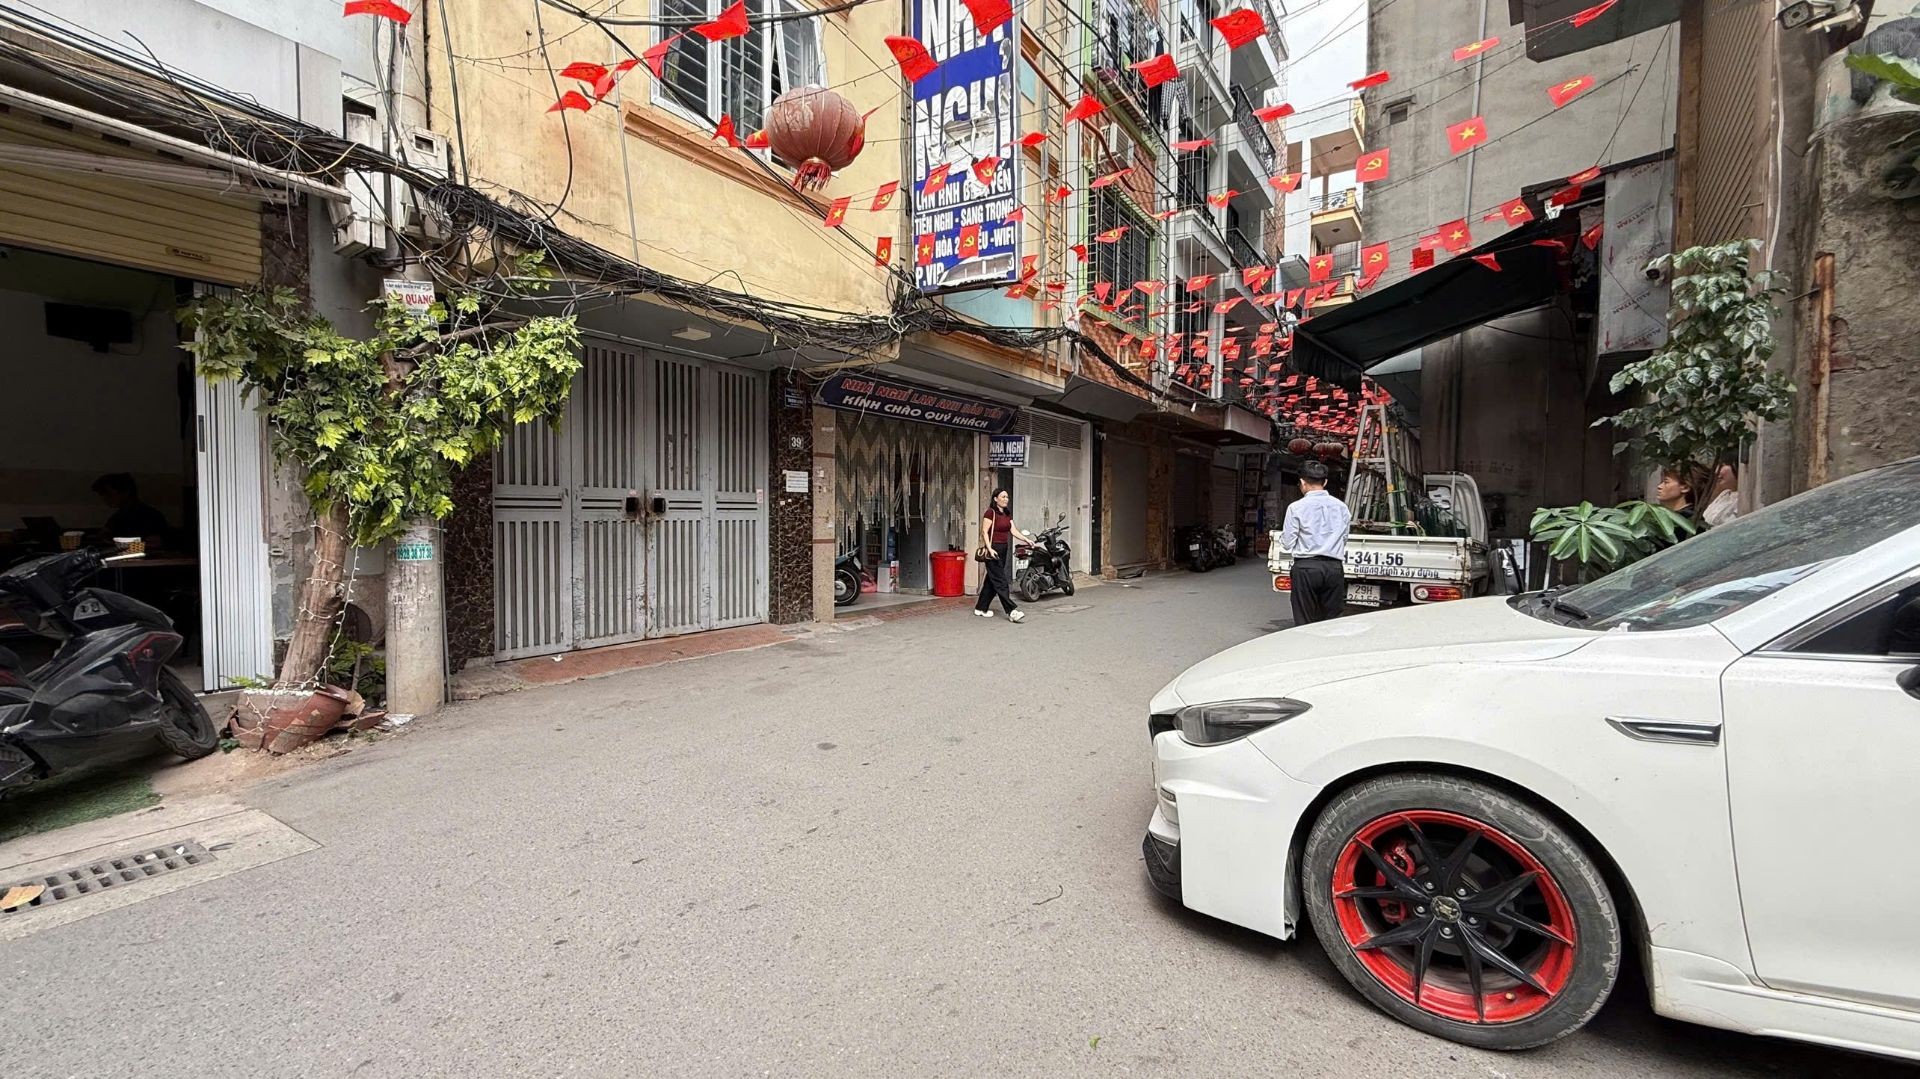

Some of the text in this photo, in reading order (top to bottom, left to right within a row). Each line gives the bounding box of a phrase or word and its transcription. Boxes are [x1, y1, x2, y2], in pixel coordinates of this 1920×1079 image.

[960, 204, 984, 227] SANG
[985, 198, 1014, 224] TRỌNG
[935, 236, 953, 258] HÒA
[405, 293, 434, 306] QUANG
[840, 377, 875, 394] NHÀ
[876, 384, 913, 402] NGHỈ
[842, 395, 989, 429] KÍNH CHÀO QUÝ KHÁCH
[791, 436, 802, 448] 39
[989, 436, 1025, 454] NHÀ NGHỈ
[1355, 585, 1373, 595] 29H
